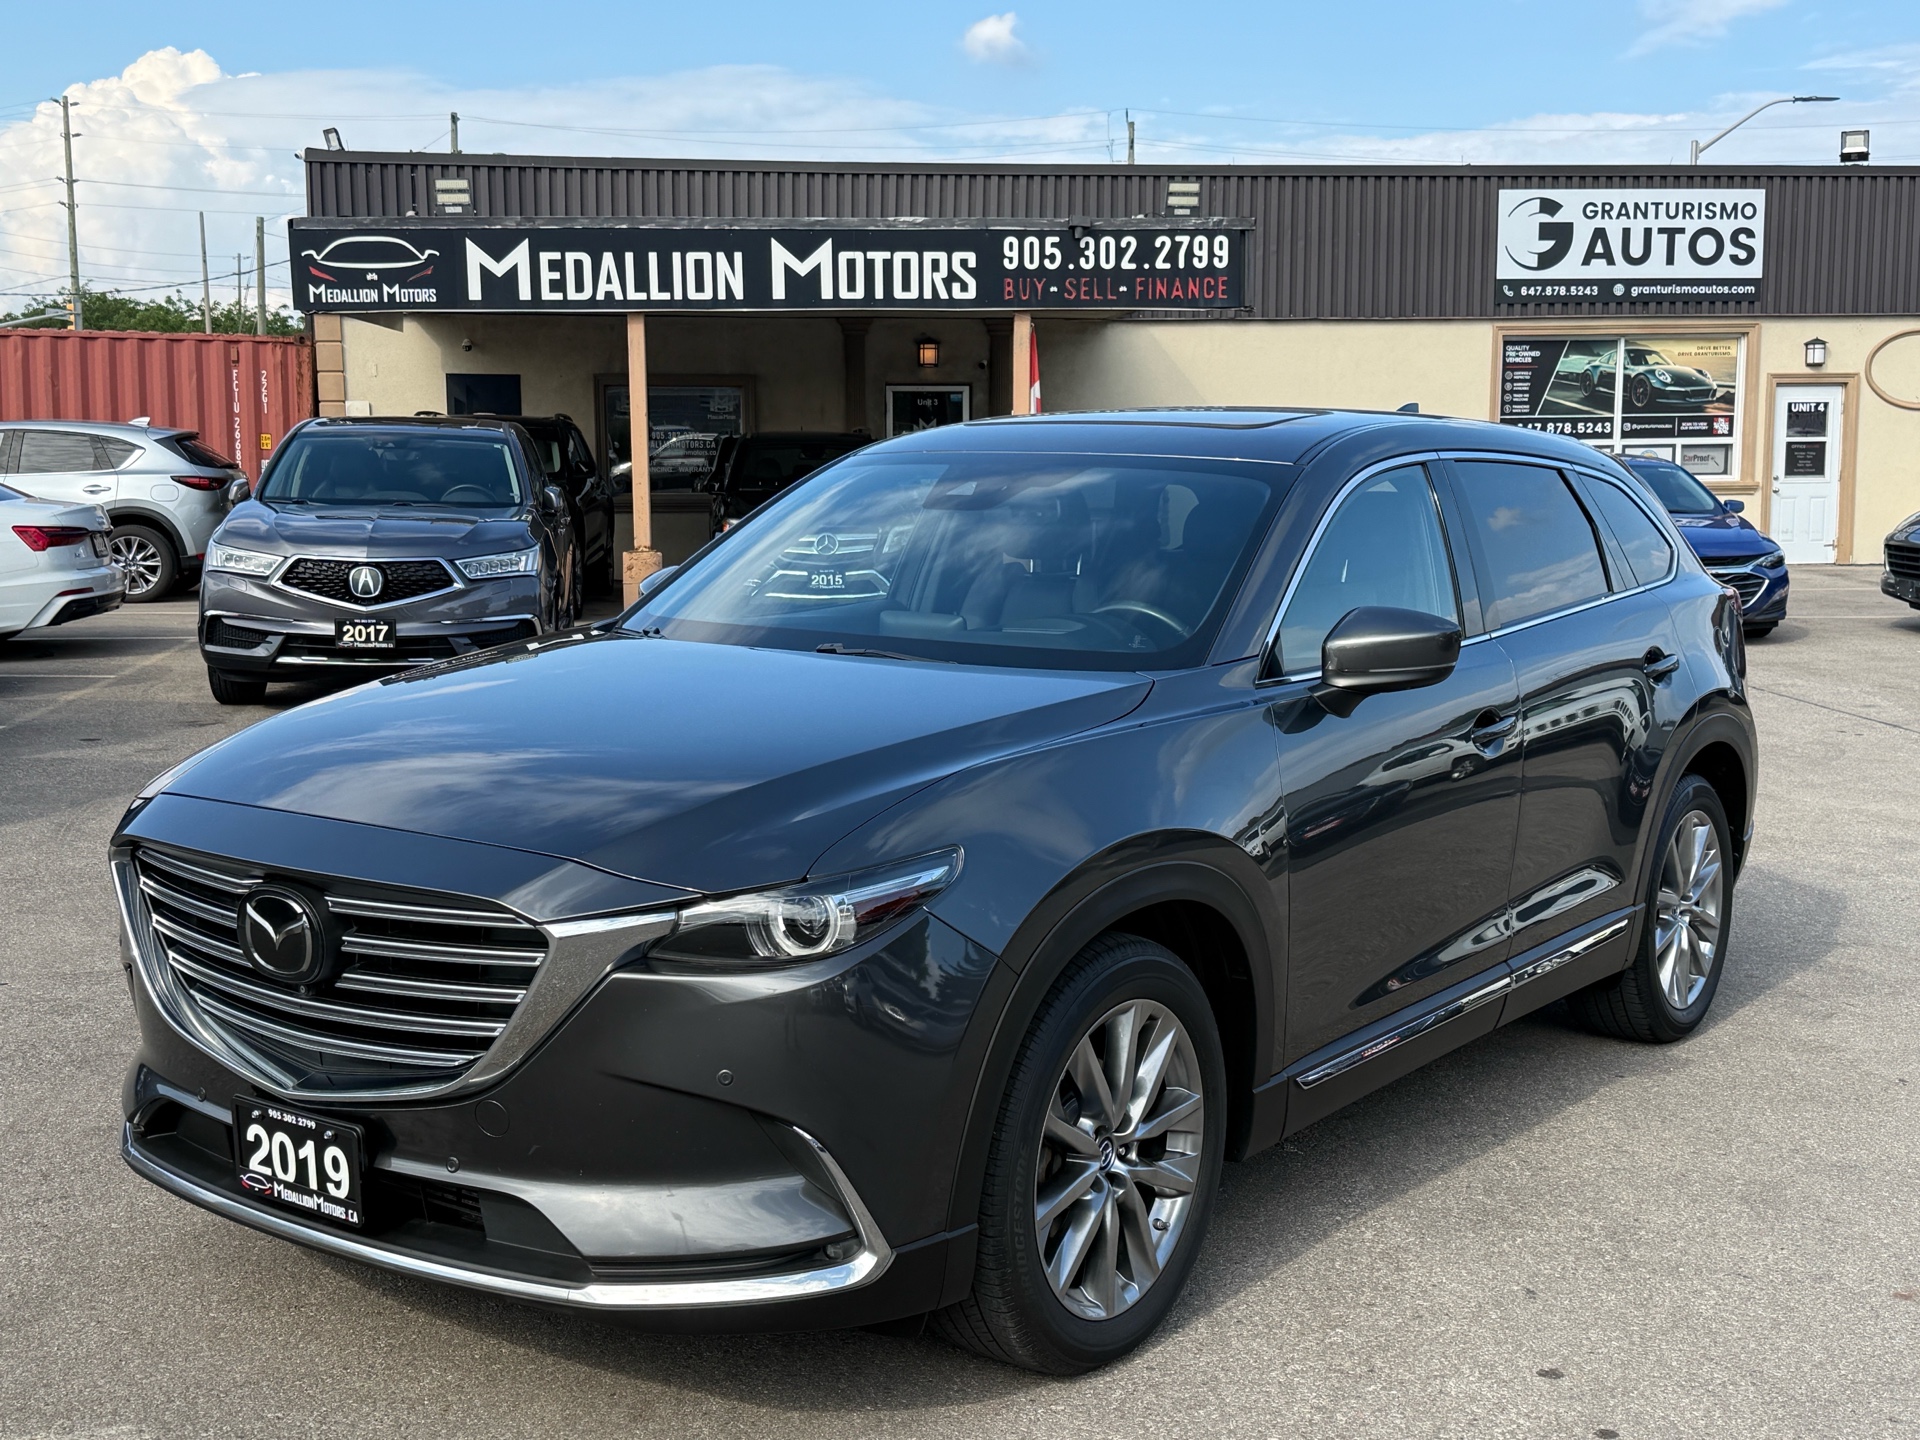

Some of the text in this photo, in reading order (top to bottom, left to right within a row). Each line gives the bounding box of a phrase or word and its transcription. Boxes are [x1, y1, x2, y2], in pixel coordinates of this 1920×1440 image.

[1582, 202, 1757, 220] GRANTURISMO
[1003, 235, 1229, 270] 905.302.2799
[1580, 227, 1756, 266] AUTOS
[465, 237, 977, 300] MEDALLION MOTORS
[308, 283, 437, 303] MEDALLION MOTORS
[1003, 276, 1229, 300] BUY SELL FINANCE
[1520, 286, 1599, 296] 647.878.5243
[1631, 284, 1755, 297] granturismoautos.com
[232, 369, 240, 413] FCIU
[1791, 402, 1825, 412] UNIT 4
[811, 574, 843, 585] 2015
[342, 625, 389, 641] 2017
[246, 1123, 350, 1199] 2019
